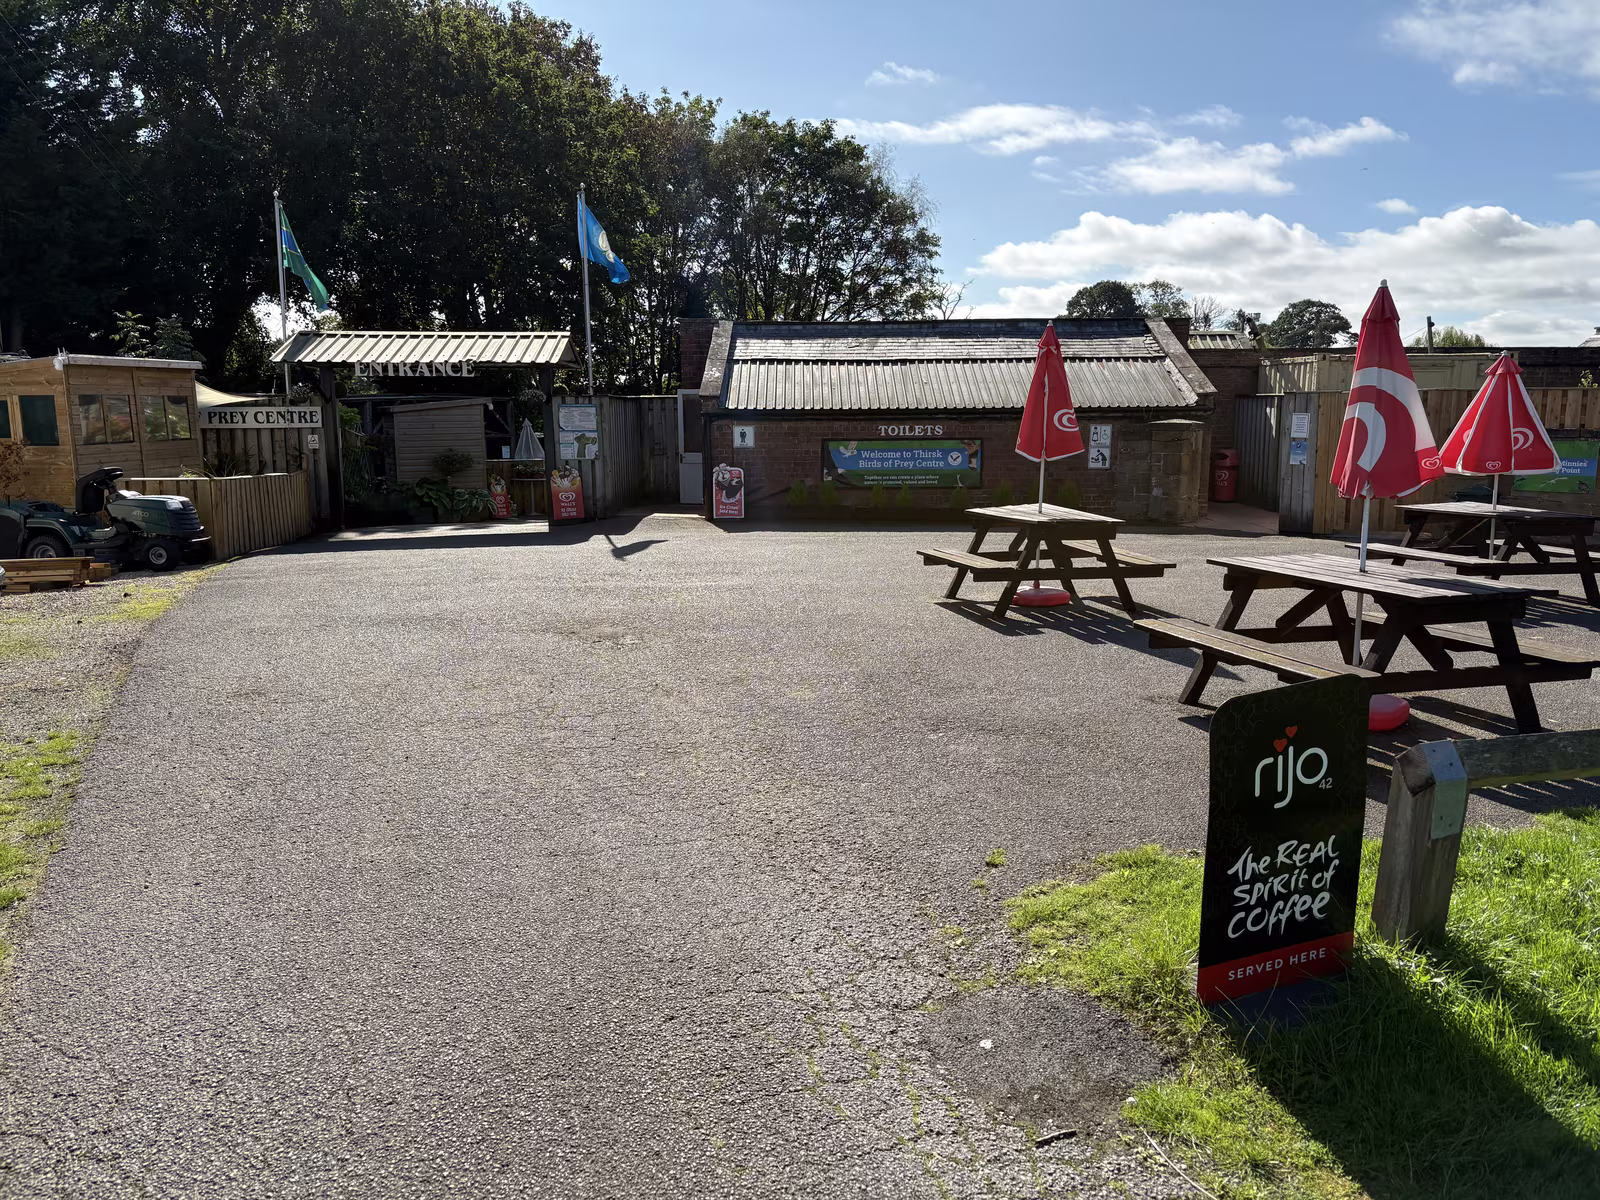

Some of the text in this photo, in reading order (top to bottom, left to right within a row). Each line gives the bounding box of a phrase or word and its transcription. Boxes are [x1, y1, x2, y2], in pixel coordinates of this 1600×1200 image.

[354, 361, 476, 377] ENTRANCE
[208, 411, 248, 424] PREY
[253, 410, 319, 424] CENTRE
[878, 425, 943, 436] TOILETS
[861, 450, 902, 458] Welcome
[913, 450, 943, 458] Thirsk
[859, 460, 945, 469] Birds of Prey Centre
[1254, 740, 1328, 809] rijo
[1318, 777, 1333, 789] 42
[1227, 846, 1271, 882] The
[1311, 859, 1340, 889] of
[1228, 948, 1327, 981] SERVED HERE
